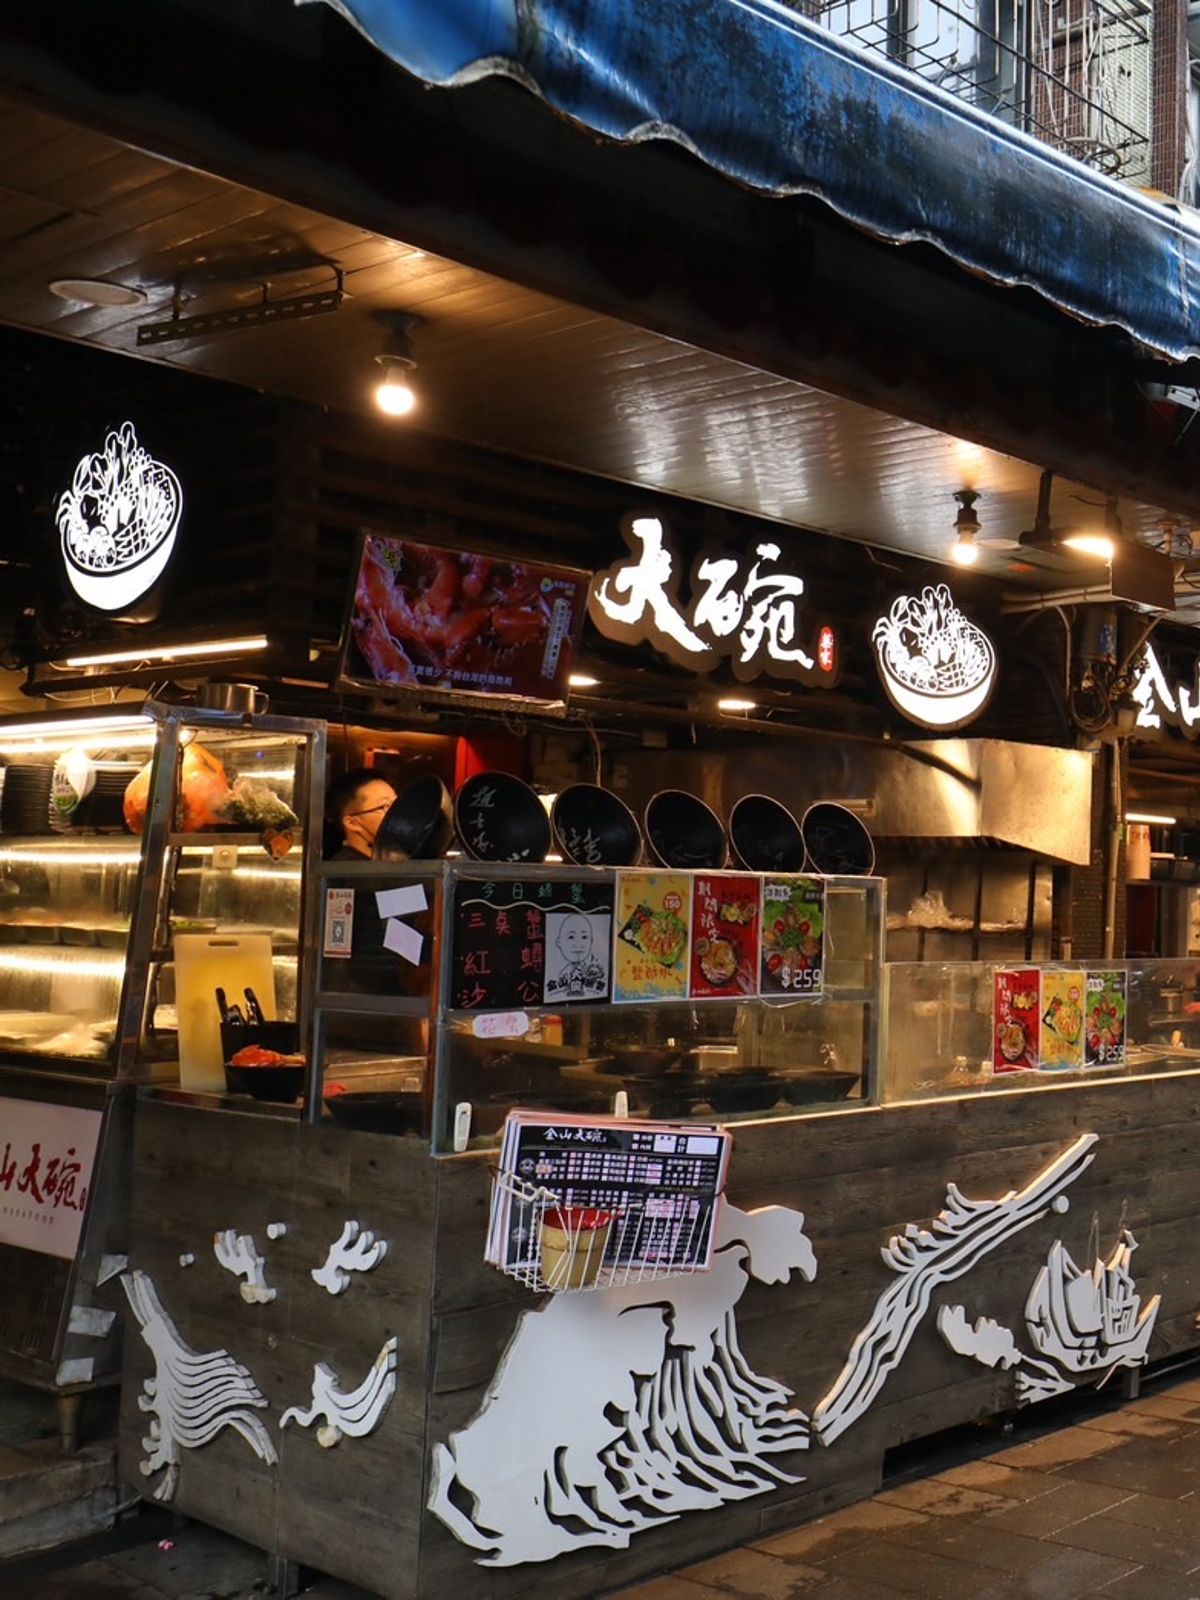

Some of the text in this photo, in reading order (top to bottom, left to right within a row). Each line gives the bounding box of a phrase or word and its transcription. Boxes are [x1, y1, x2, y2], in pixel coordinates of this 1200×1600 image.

[594, 517, 815, 669] 大碗
[664, 900, 681, 909] 150
[782, 968, 822, 988] $259
